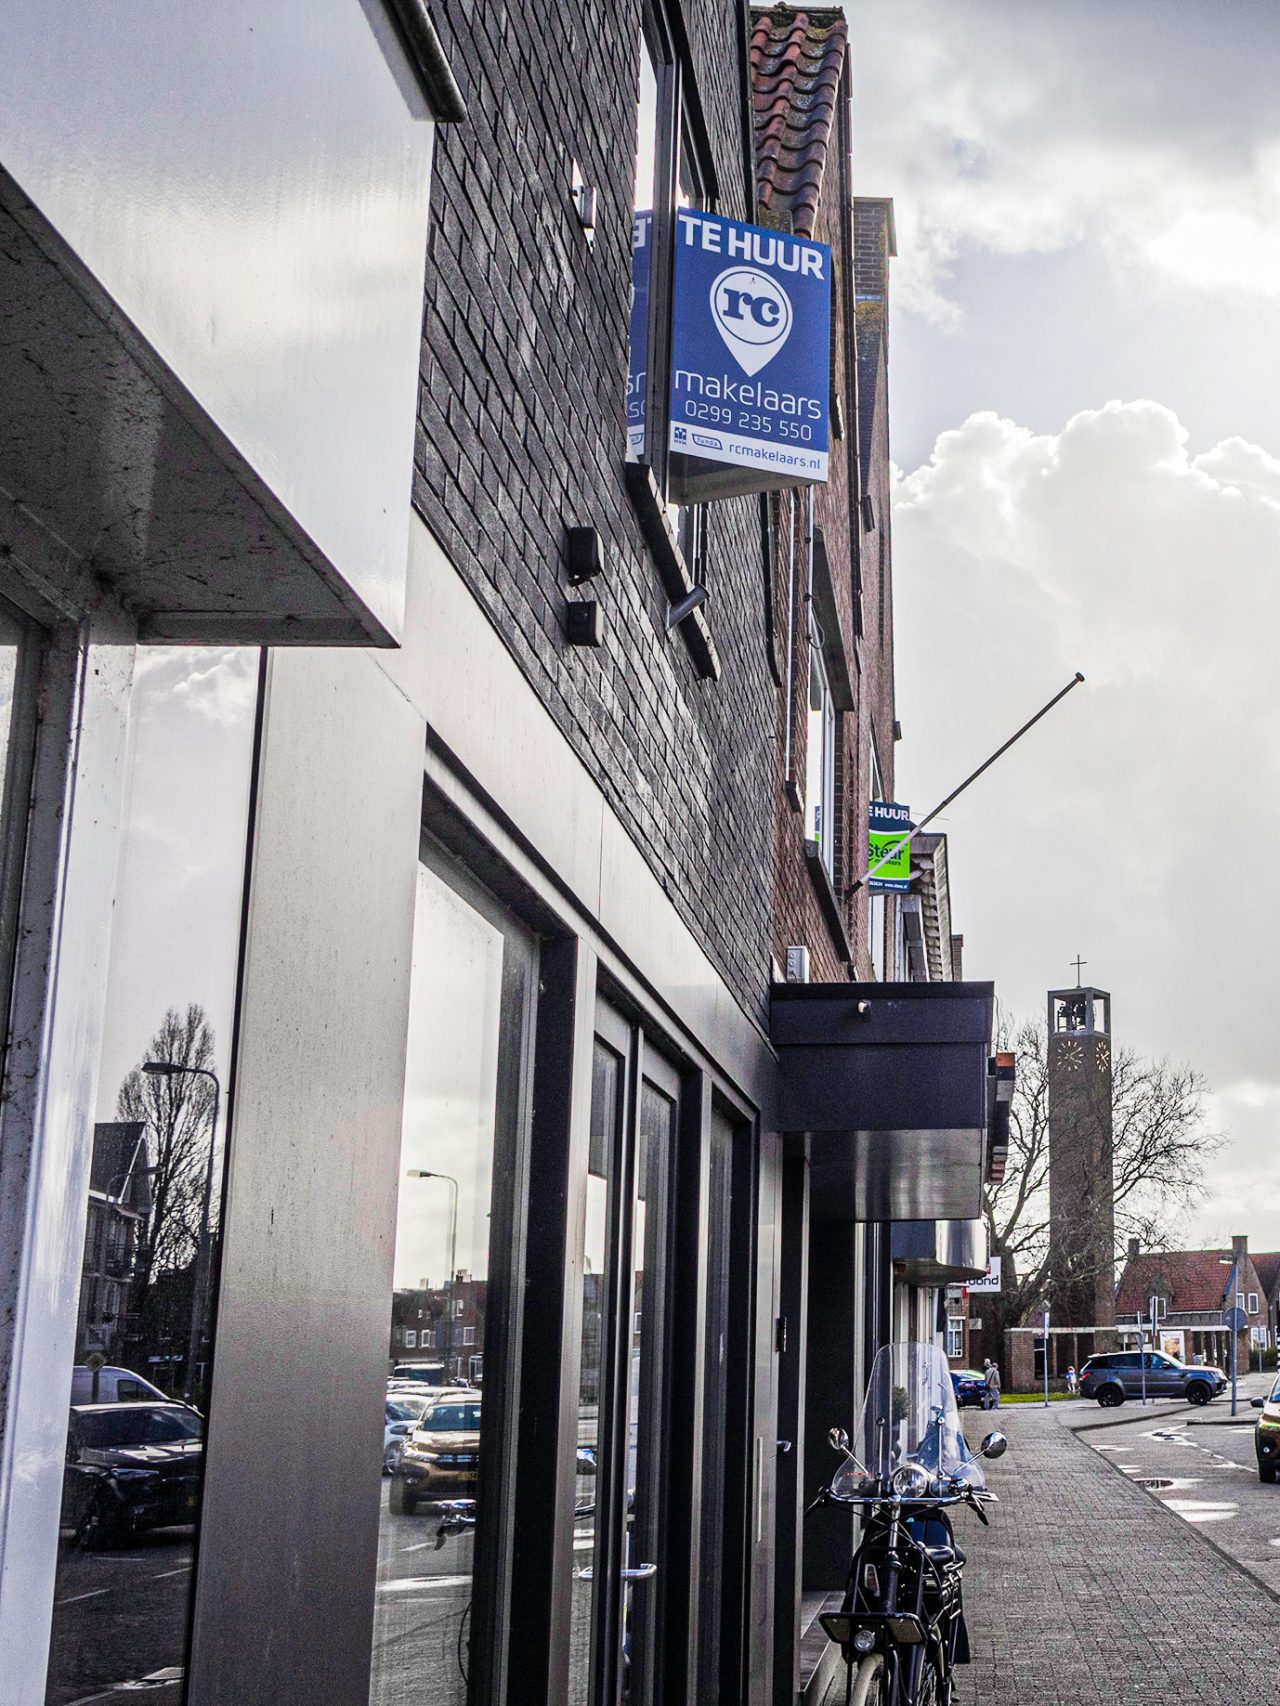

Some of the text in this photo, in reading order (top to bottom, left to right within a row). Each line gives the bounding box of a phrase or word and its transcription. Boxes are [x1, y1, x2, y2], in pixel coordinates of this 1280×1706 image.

[678, 214, 721, 253] TE
[728, 226, 825, 280] HUUR
[722, 287, 780, 327] rc
[674, 370, 822, 420] makelaars
[685, 400, 812, 441] 0299 235 550
[729, 444, 821, 470] rcmakelaars.nl
[874, 806, 909, 821] HUUR
